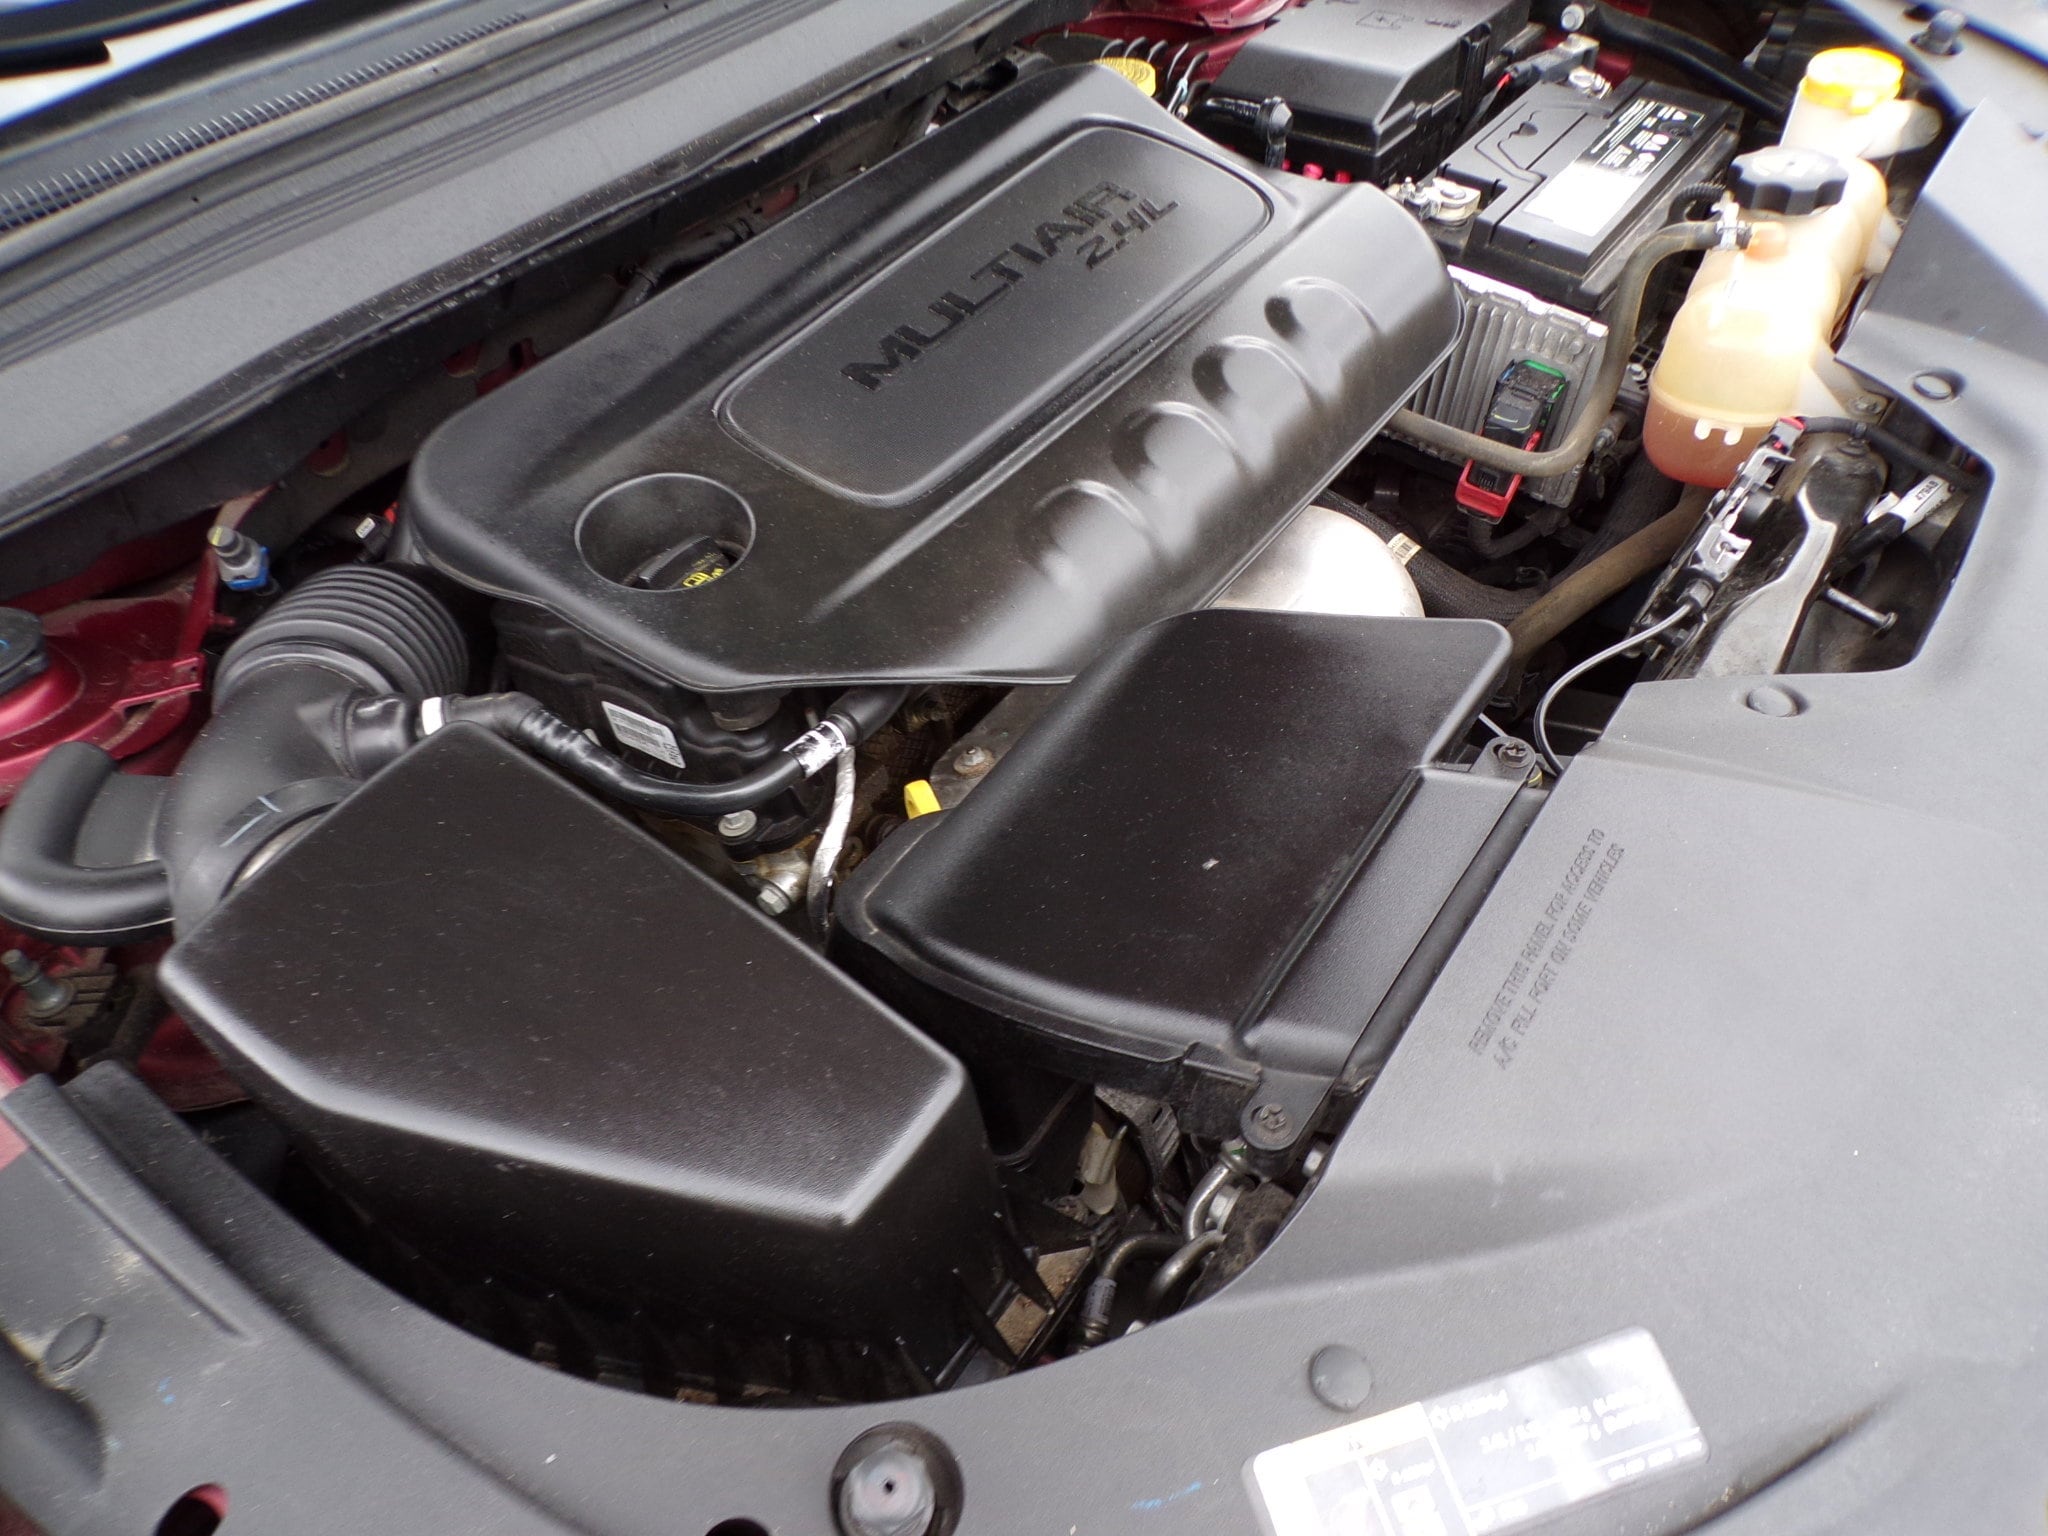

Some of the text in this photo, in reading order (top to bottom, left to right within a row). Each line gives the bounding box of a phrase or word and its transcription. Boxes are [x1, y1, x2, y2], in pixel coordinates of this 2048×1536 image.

[840, 180, 1138, 391] MULTIAIR
[1076, 198, 1179, 270] 2.4L
[1469, 828, 1606, 1055] REMOVE THIS PANEL FOR ACCESS TO
[1492, 842, 1626, 1070] A/C FILL PORT ON SOME VEHICLES
